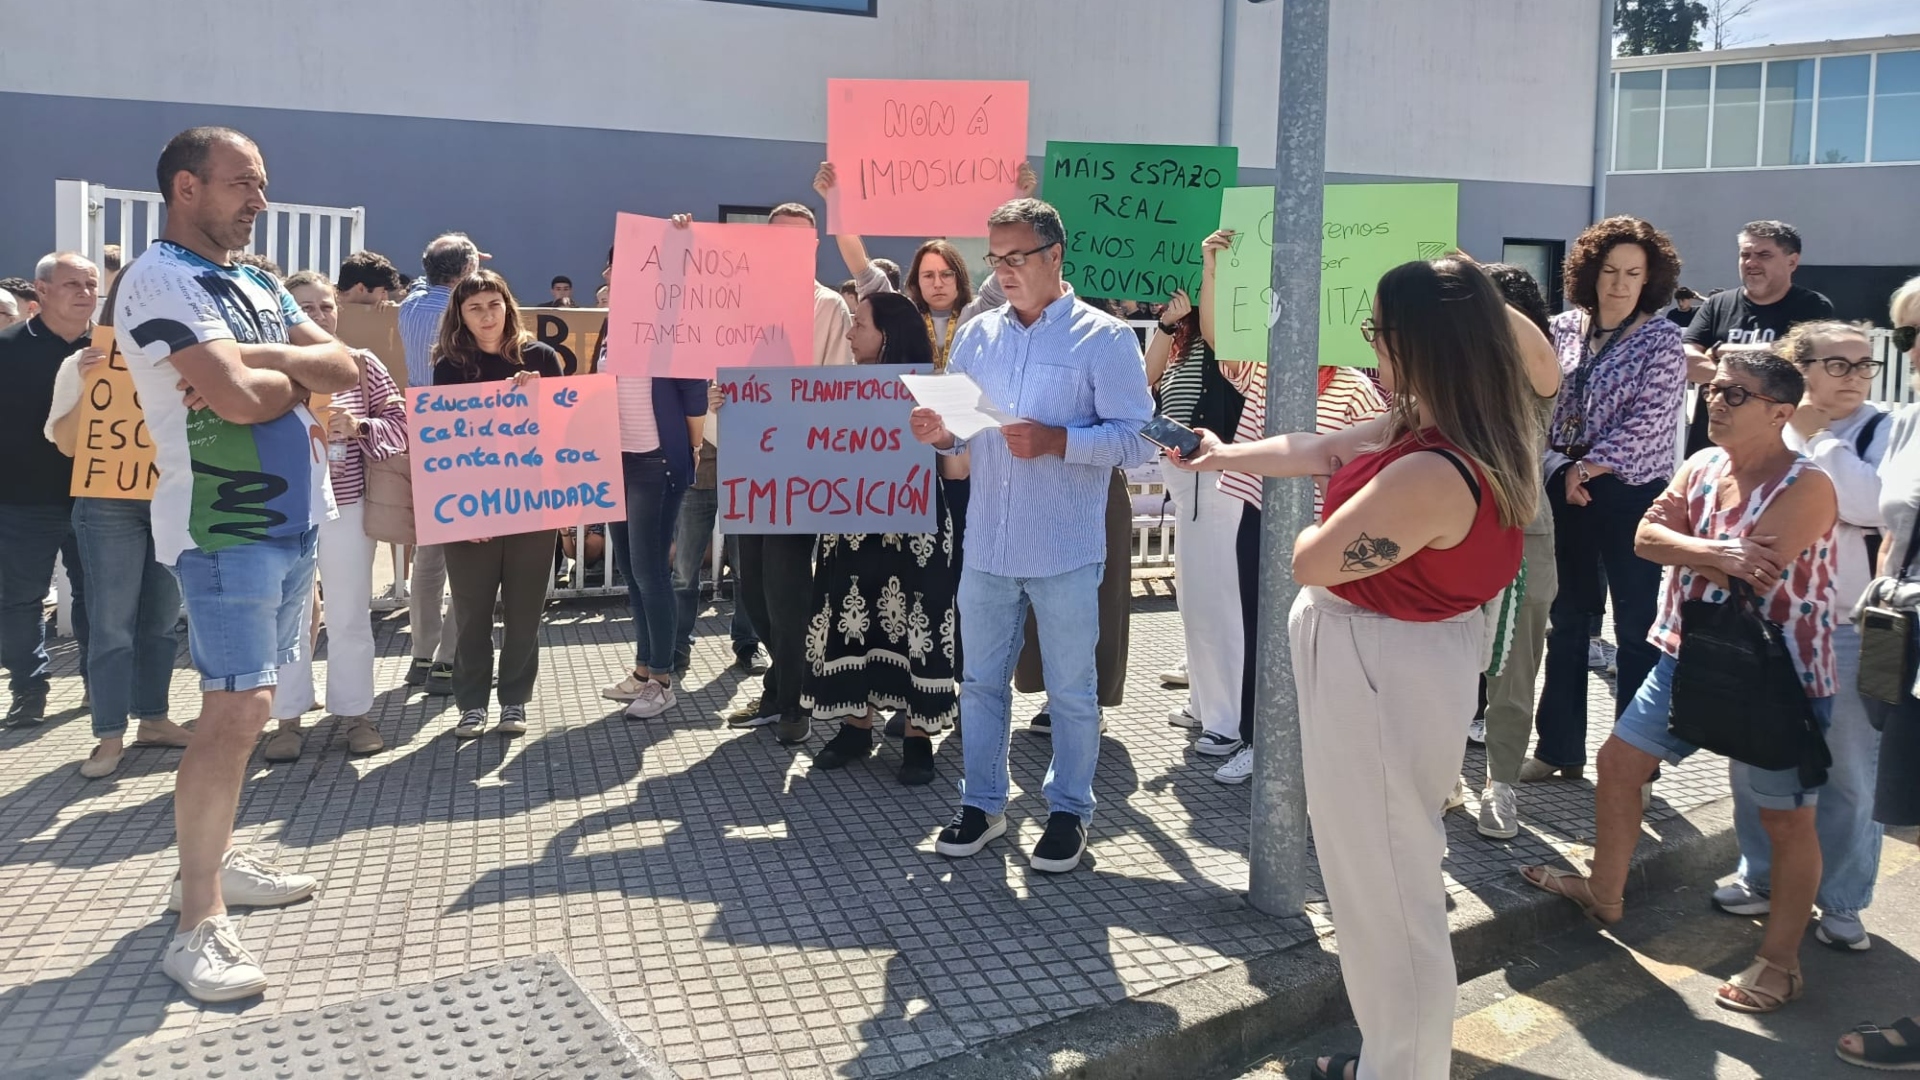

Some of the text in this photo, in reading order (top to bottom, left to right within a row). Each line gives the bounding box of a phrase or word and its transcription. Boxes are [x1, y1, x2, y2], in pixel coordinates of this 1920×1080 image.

[883, 94, 993, 138] NON Á
[1054, 152, 1222, 189] MÁIS ESPAZO
[1089, 193, 1178, 225] REAL
[640, 244, 750, 279] A NOSA
[1150, 239, 1204, 265] AUL
[632, 318, 701, 345] TAMÉN
[414, 384, 579, 415] Educación de
[721, 369, 917, 404] MÁIS PLANIFICACIÓ
[760, 425, 902, 454] E MENOS
[423, 446, 601, 473] contando coa
[434, 481, 617, 524] COMUNIDADE
[721, 464, 932, 527] IMPOSICIÓN
